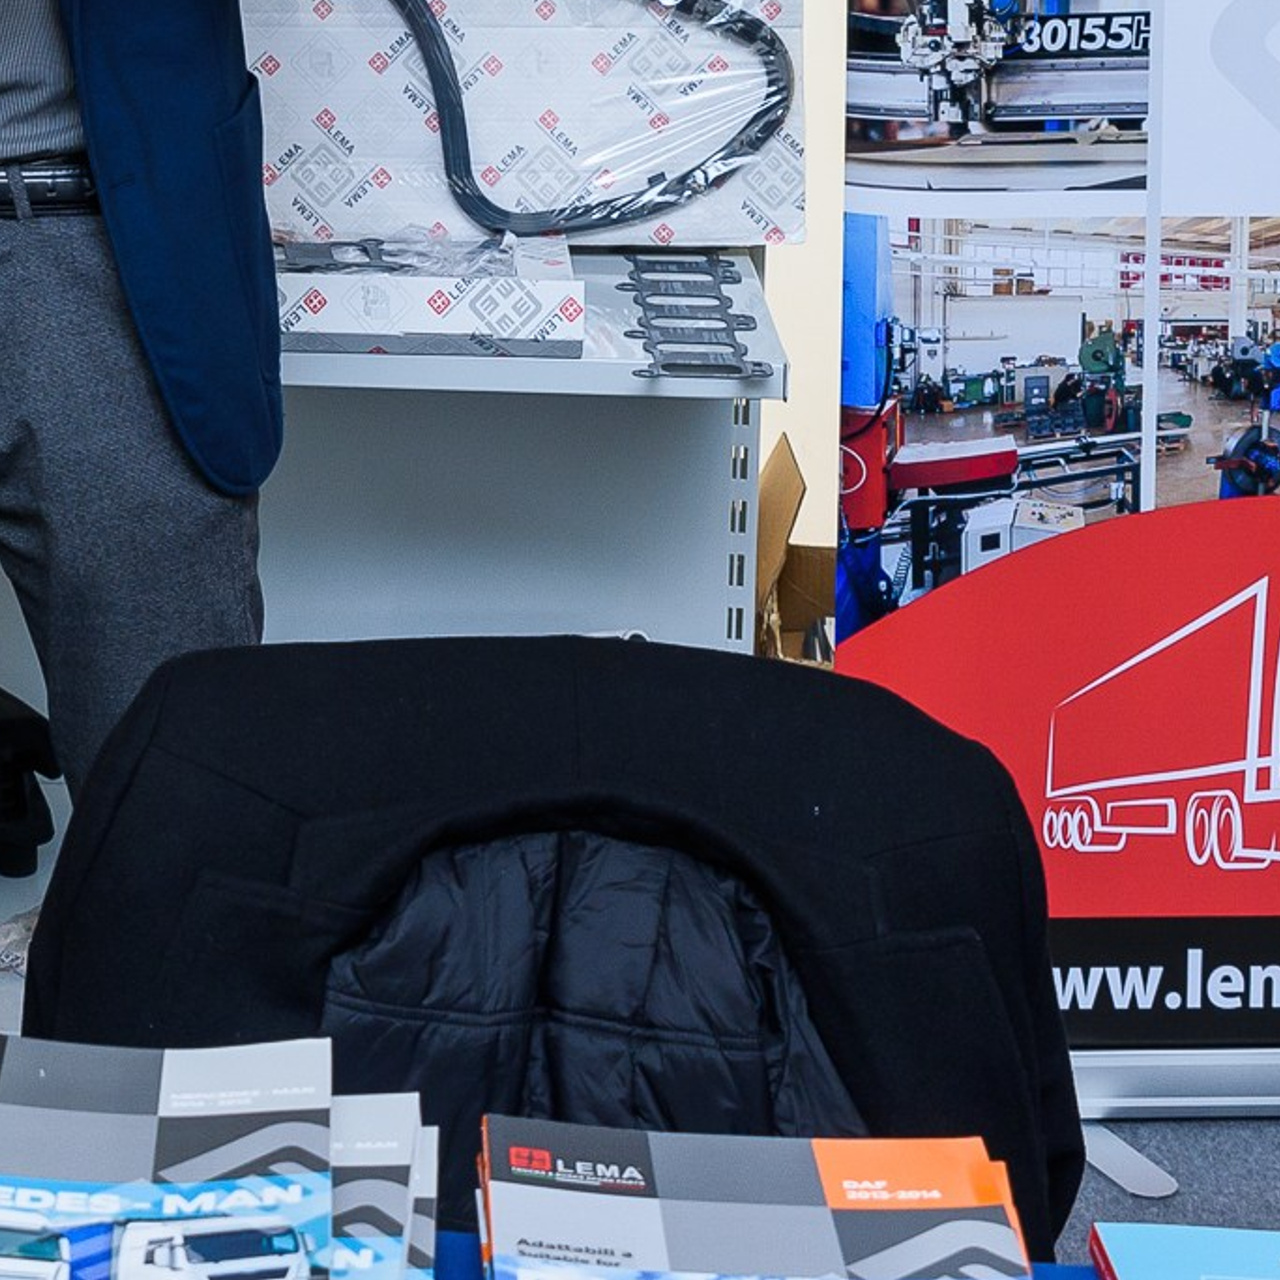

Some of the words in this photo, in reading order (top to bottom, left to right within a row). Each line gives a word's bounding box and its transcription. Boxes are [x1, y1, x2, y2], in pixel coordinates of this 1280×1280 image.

[402, 84, 431, 115] LEMA
[326, 124, 355, 155] LEMA
[273, 142, 303, 171] LEMA
[343, 179, 374, 208] LEMA
[291, 197, 320, 227] LEMA
[556, 1158, 643, 1180] LEMA
[162, 1183, 304, 1214] MAN
